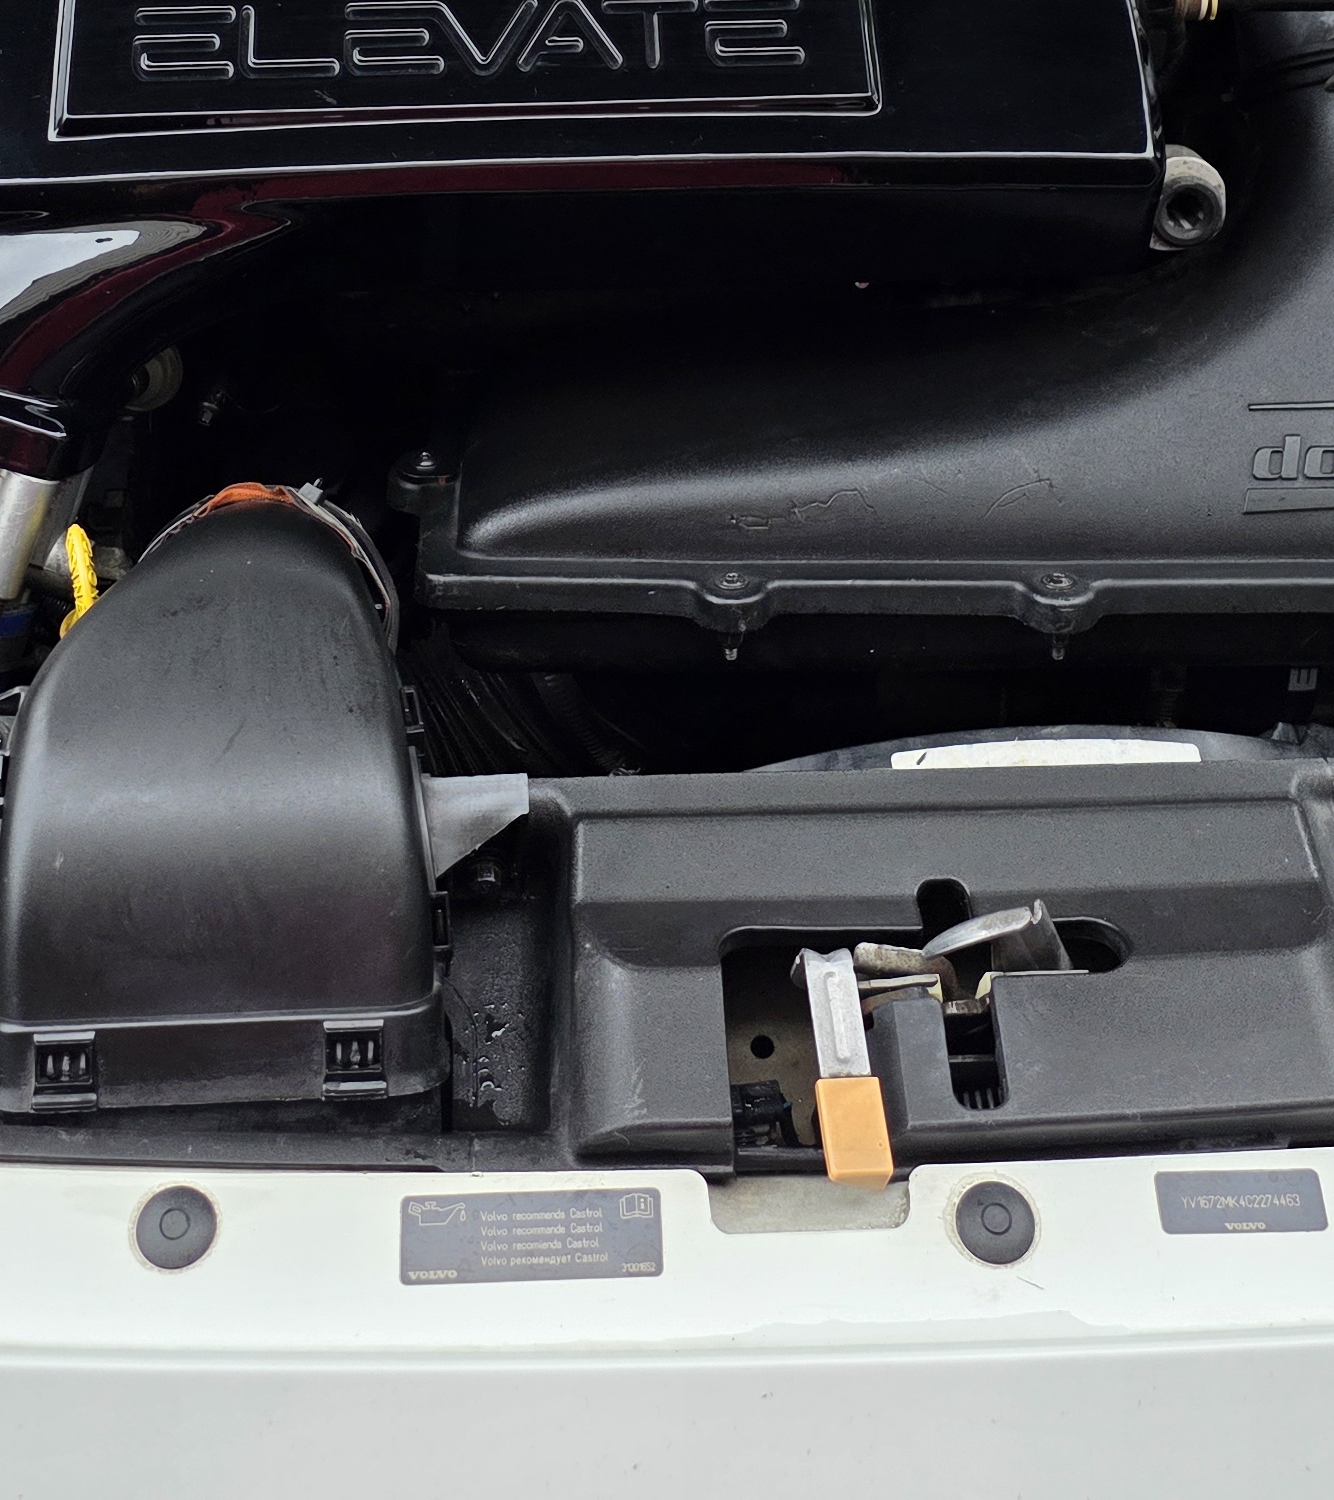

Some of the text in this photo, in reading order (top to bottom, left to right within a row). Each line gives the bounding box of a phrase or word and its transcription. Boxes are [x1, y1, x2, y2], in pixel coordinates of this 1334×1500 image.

[1181, 1193, 1300, 1209] YV1672MK4C2274463
[480, 1208, 603, 1222] Volvo recommends Castrol
[480, 1226, 508, 1236] Volvo
[570, 1223, 604, 1234] Castrol
[1224, 1222, 1267, 1230] VOLVO
[480, 1241, 508, 1251] Volvo
[567, 1238, 600, 1248] Castrol
[481, 1252, 609, 1268] Volvo рекомендует Castrol
[407, 1270, 458, 1280] VOLVO
